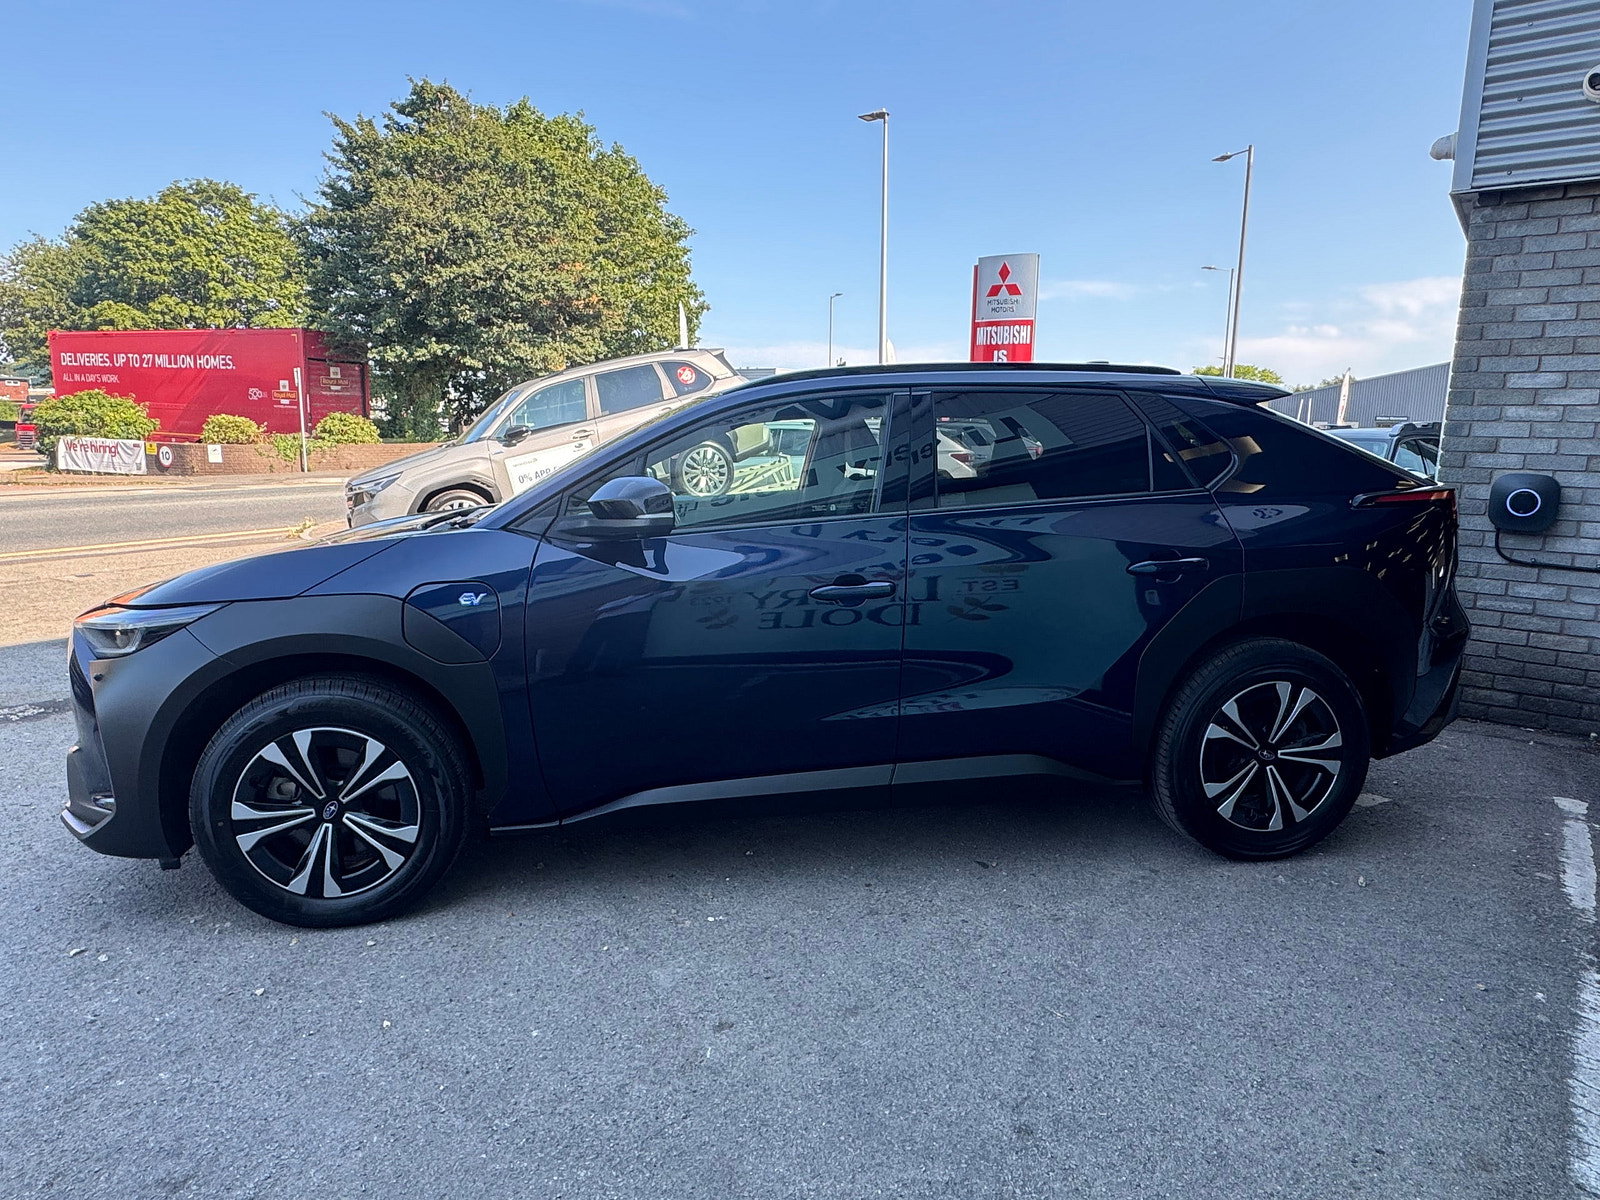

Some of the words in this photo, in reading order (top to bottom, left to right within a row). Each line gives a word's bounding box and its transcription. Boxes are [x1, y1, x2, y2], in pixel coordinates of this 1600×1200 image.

[987, 298, 1019, 306] MITSUBISHI
[976, 325, 1031, 346] MITSUBISHI
[60, 352, 113, 367] DELIVERIES.
[113, 353, 127, 368] UP
[127, 353, 140, 368] TO
[142, 354, 153, 368] 27
[154, 354, 195, 369] MILLION
[196, 354, 236, 370] HOMES.
[993, 350, 1008, 362] IS
[63, 373, 73, 382] ALL
[161, 451, 171, 461] 10
[518, 472, 533, 484] 0%
